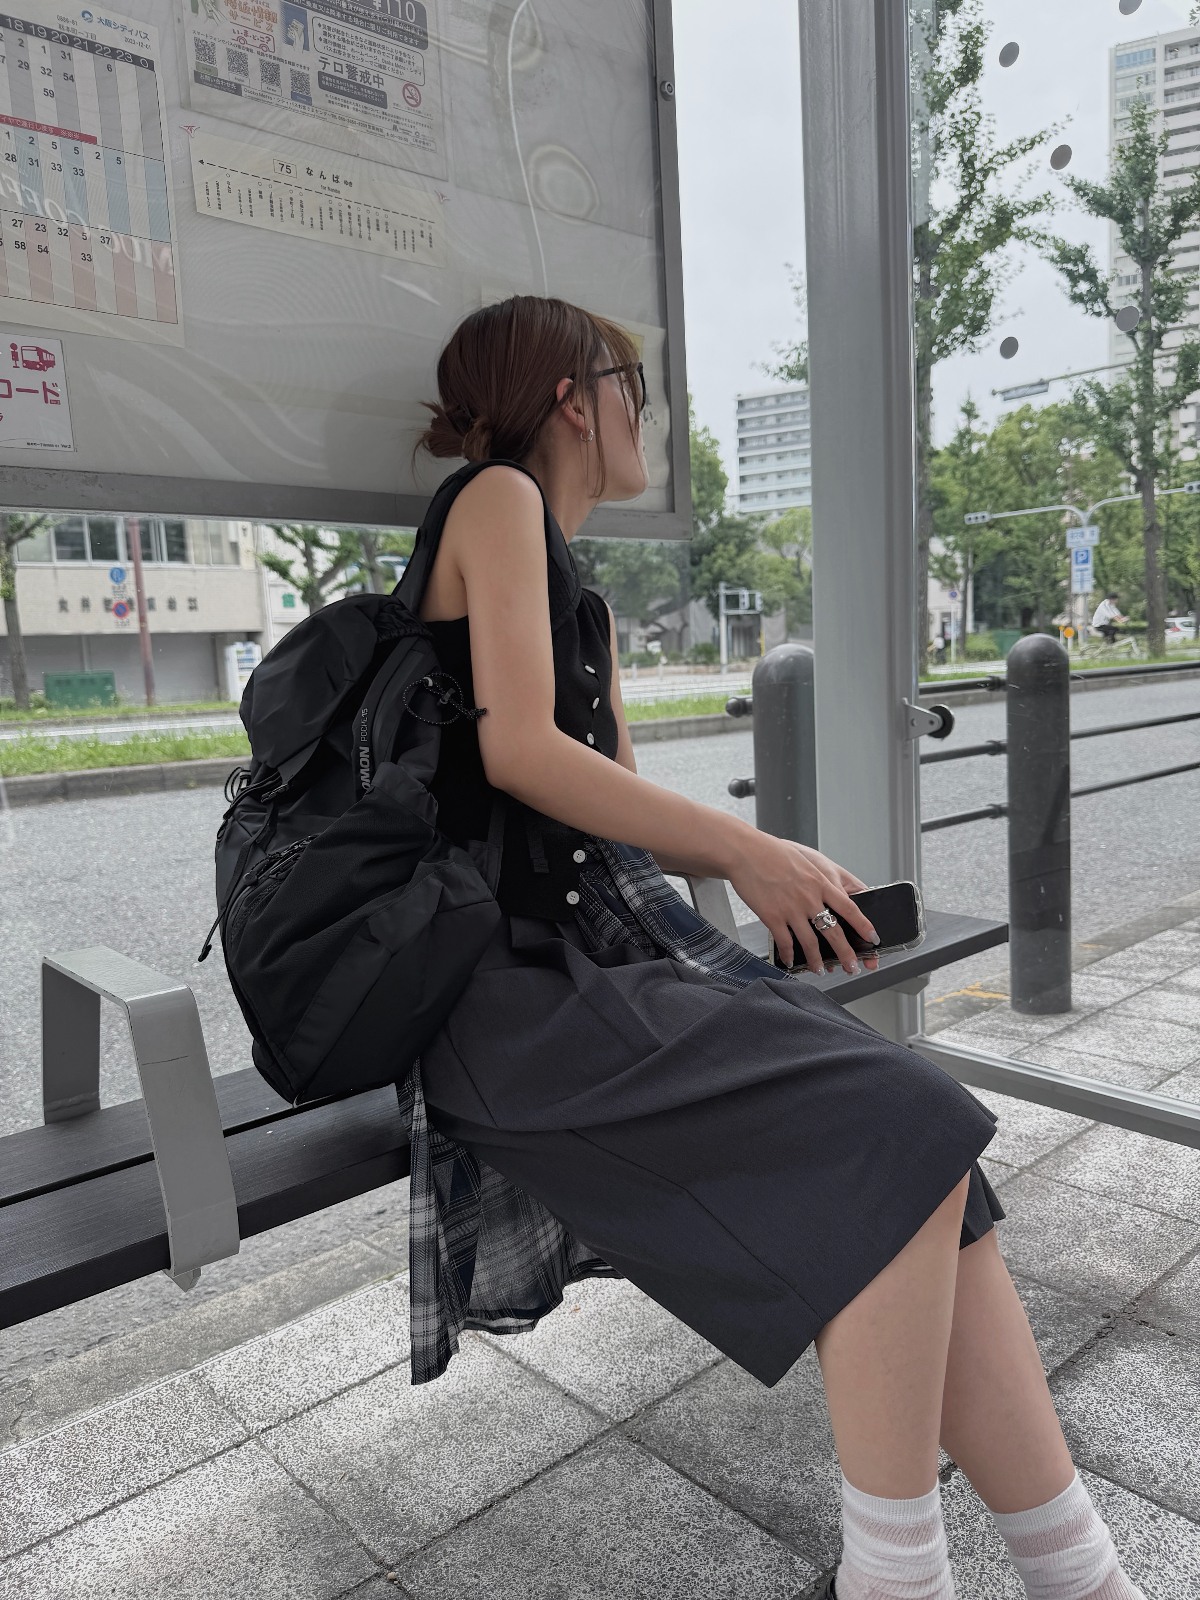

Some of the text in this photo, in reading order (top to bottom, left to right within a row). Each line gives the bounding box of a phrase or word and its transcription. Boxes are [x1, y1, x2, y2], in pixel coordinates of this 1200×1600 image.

[97, 16, 151, 41] 大阪シティバス
[6, 17, 149, 69] 18 19 20 21 22 23 0
[18, 37, 25, 48] 2
[41, 44, 47, 55] 1
[60, 50, 73, 62] 31
[106, 63, 113, 73] 6
[17, 59, 30, 71] 29
[40, 65, 53, 78] 32
[63, 73, 75, 83] 54
[318, 56, 385, 89] テロ警戒中
[43, 88, 55, 99] 59
[5, 131, 122, 165] 1 2 5 5 2 5
[28, 157, 40, 168] 31
[51, 162, 63, 172] 33
[72, 167, 85, 177] 33
[278, 162, 292, 175] 75
[12, 218, 111, 246] 27 23 32 5 37
[14, 240, 26, 251] 58
[38, 244, 49, 254] 54
[81, 253, 93, 263] 33
